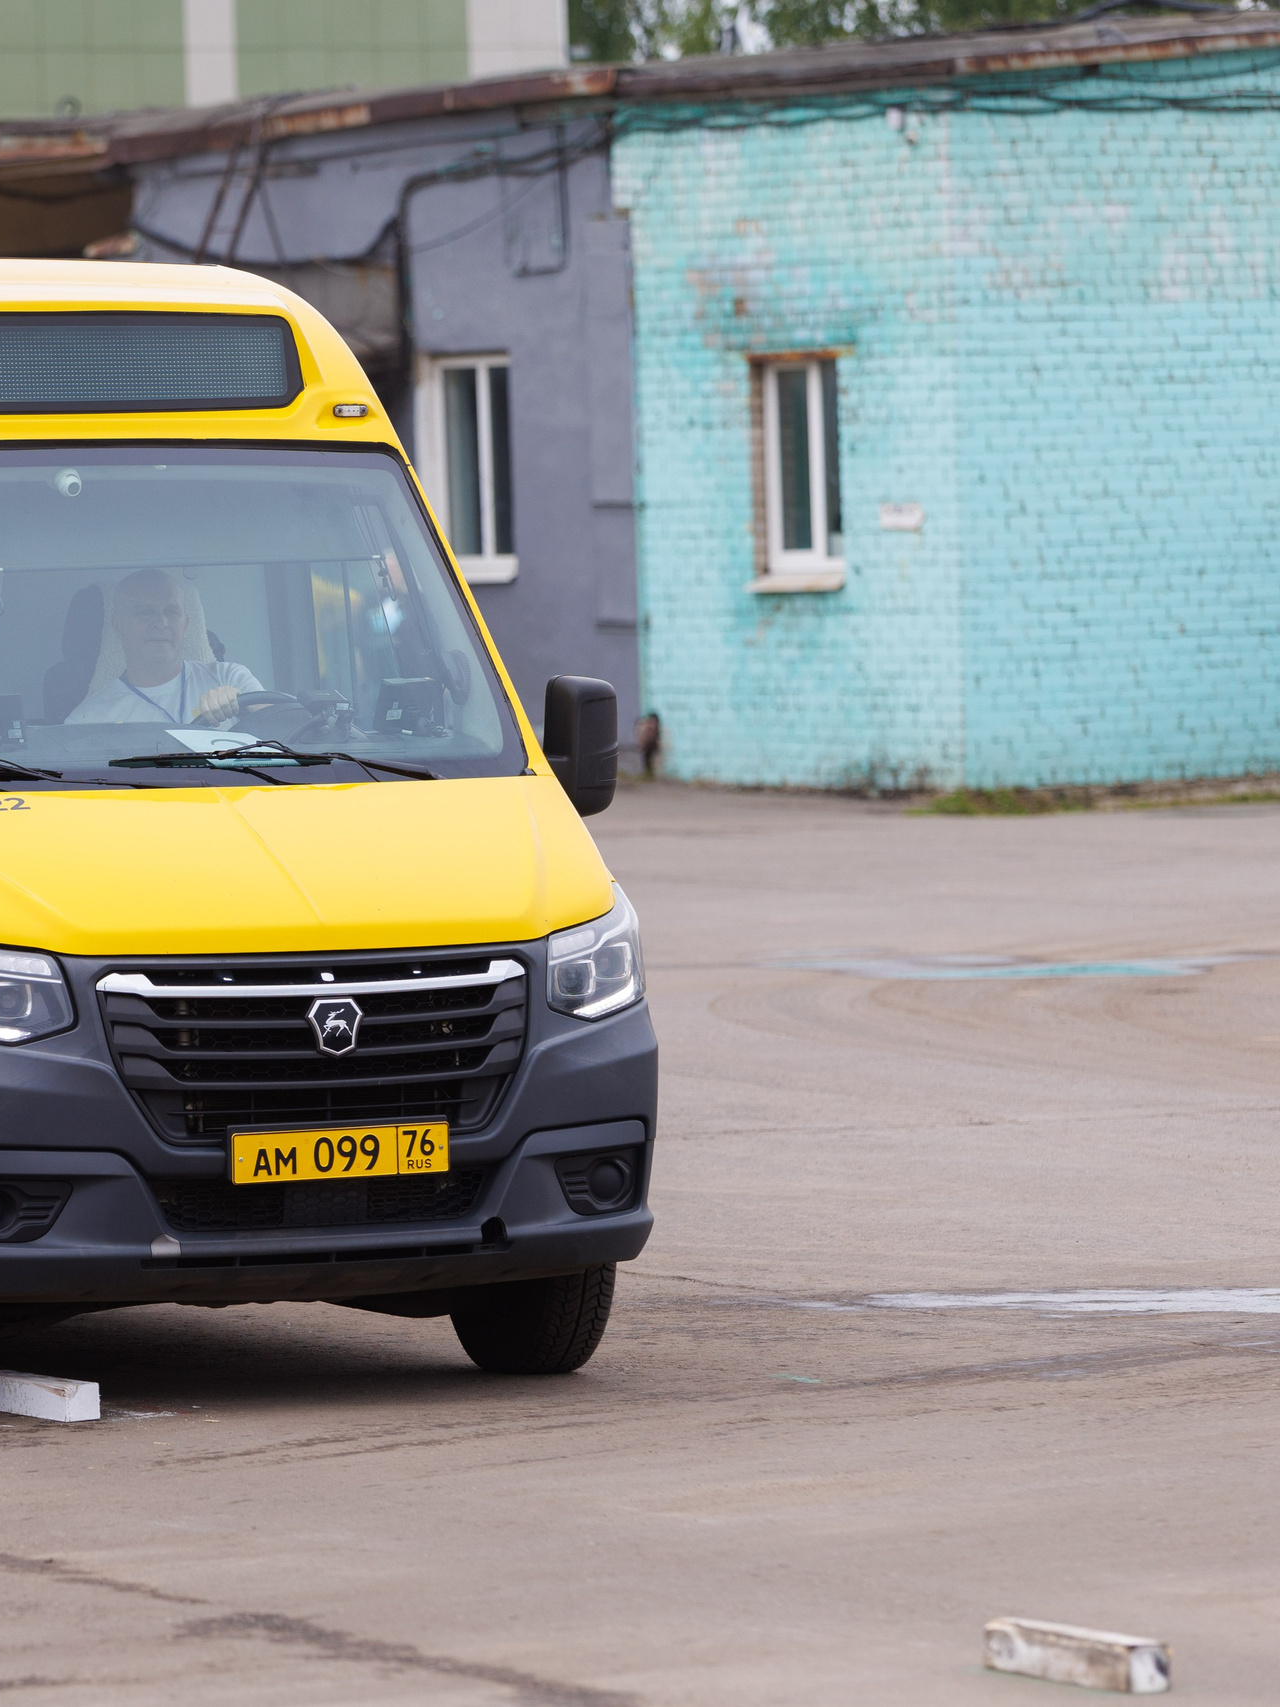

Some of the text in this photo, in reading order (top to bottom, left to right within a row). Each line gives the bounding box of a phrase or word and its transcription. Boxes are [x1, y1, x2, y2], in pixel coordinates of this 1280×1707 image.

[313, 1133, 380, 1173] 099
[402, 1128, 436, 1158] 76
[407, 1158, 432, 1170] RUS
